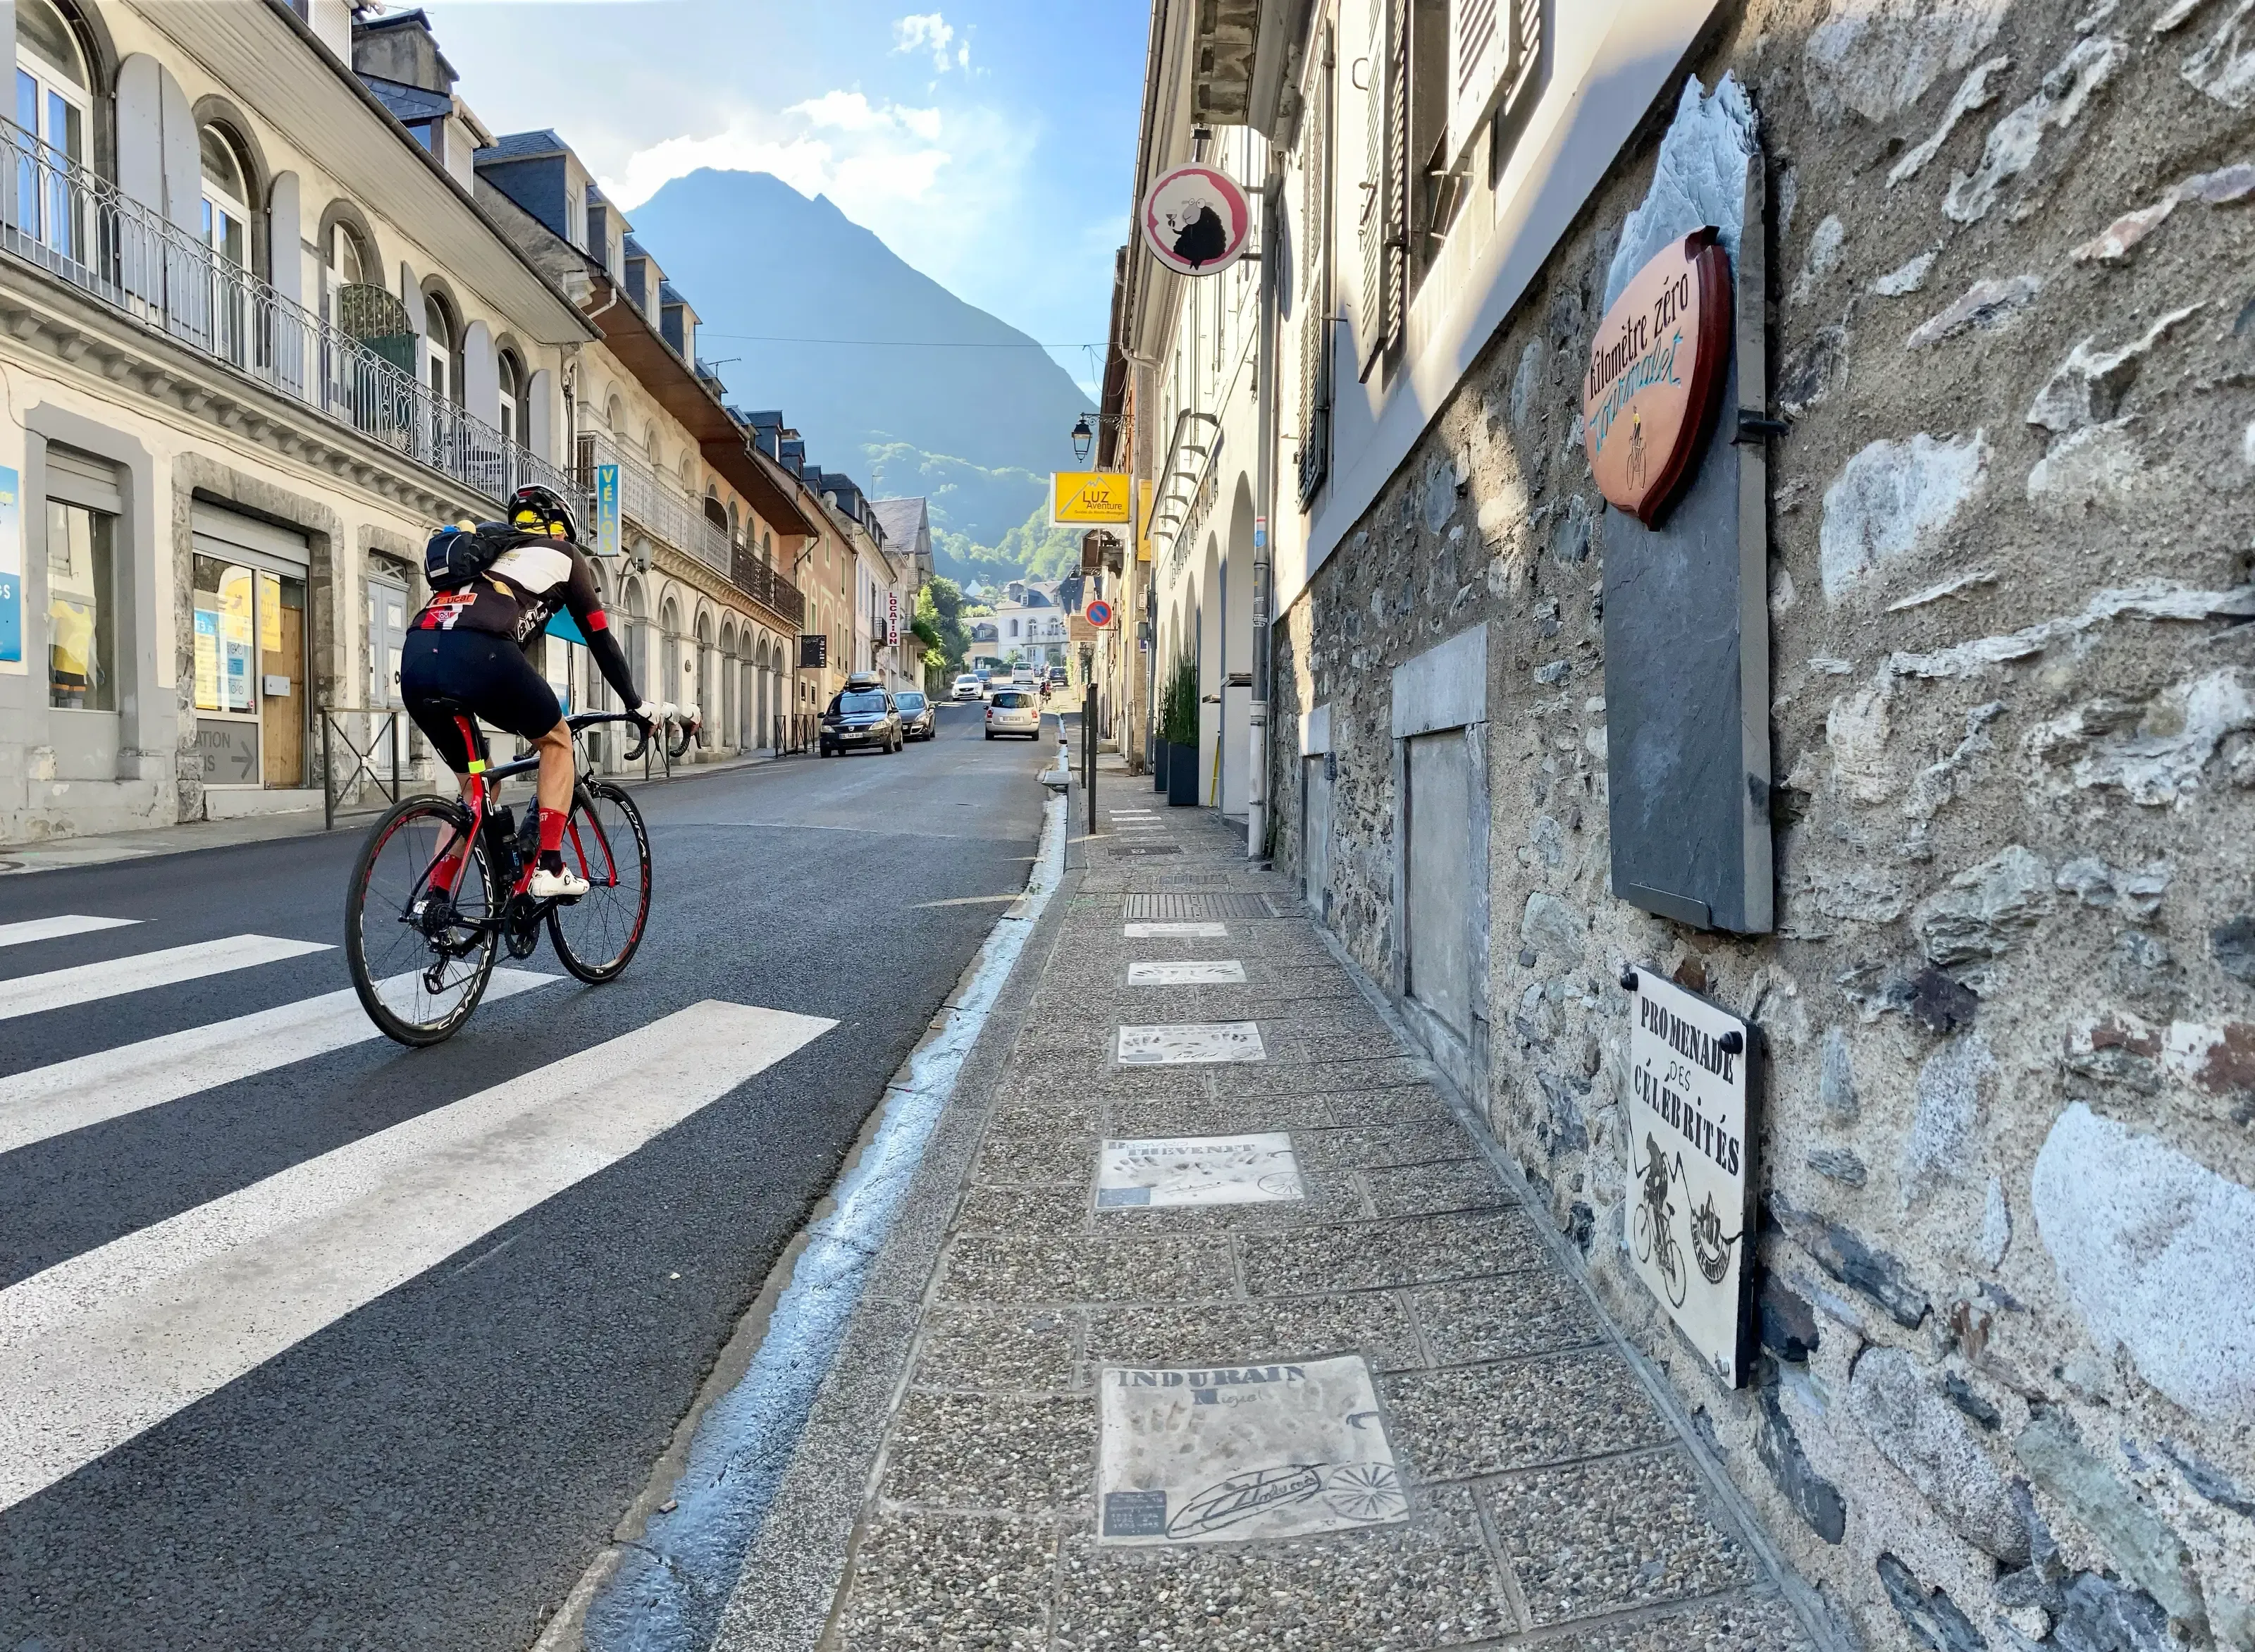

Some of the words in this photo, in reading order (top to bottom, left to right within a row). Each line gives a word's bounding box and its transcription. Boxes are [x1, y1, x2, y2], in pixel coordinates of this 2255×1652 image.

[1654, 273, 1688, 340] zéro
[601, 469, 614, 552] VÉLOS
[1082, 491, 1110, 503] LUZ
[447, 594, 472, 604] ucar
[619, 801, 648, 858] BORA
[1641, 996, 1734, 1085] PROMENADE
[1669, 1060, 1691, 1091] DES
[1118, 1366, 1306, 1387] INDURAIN
